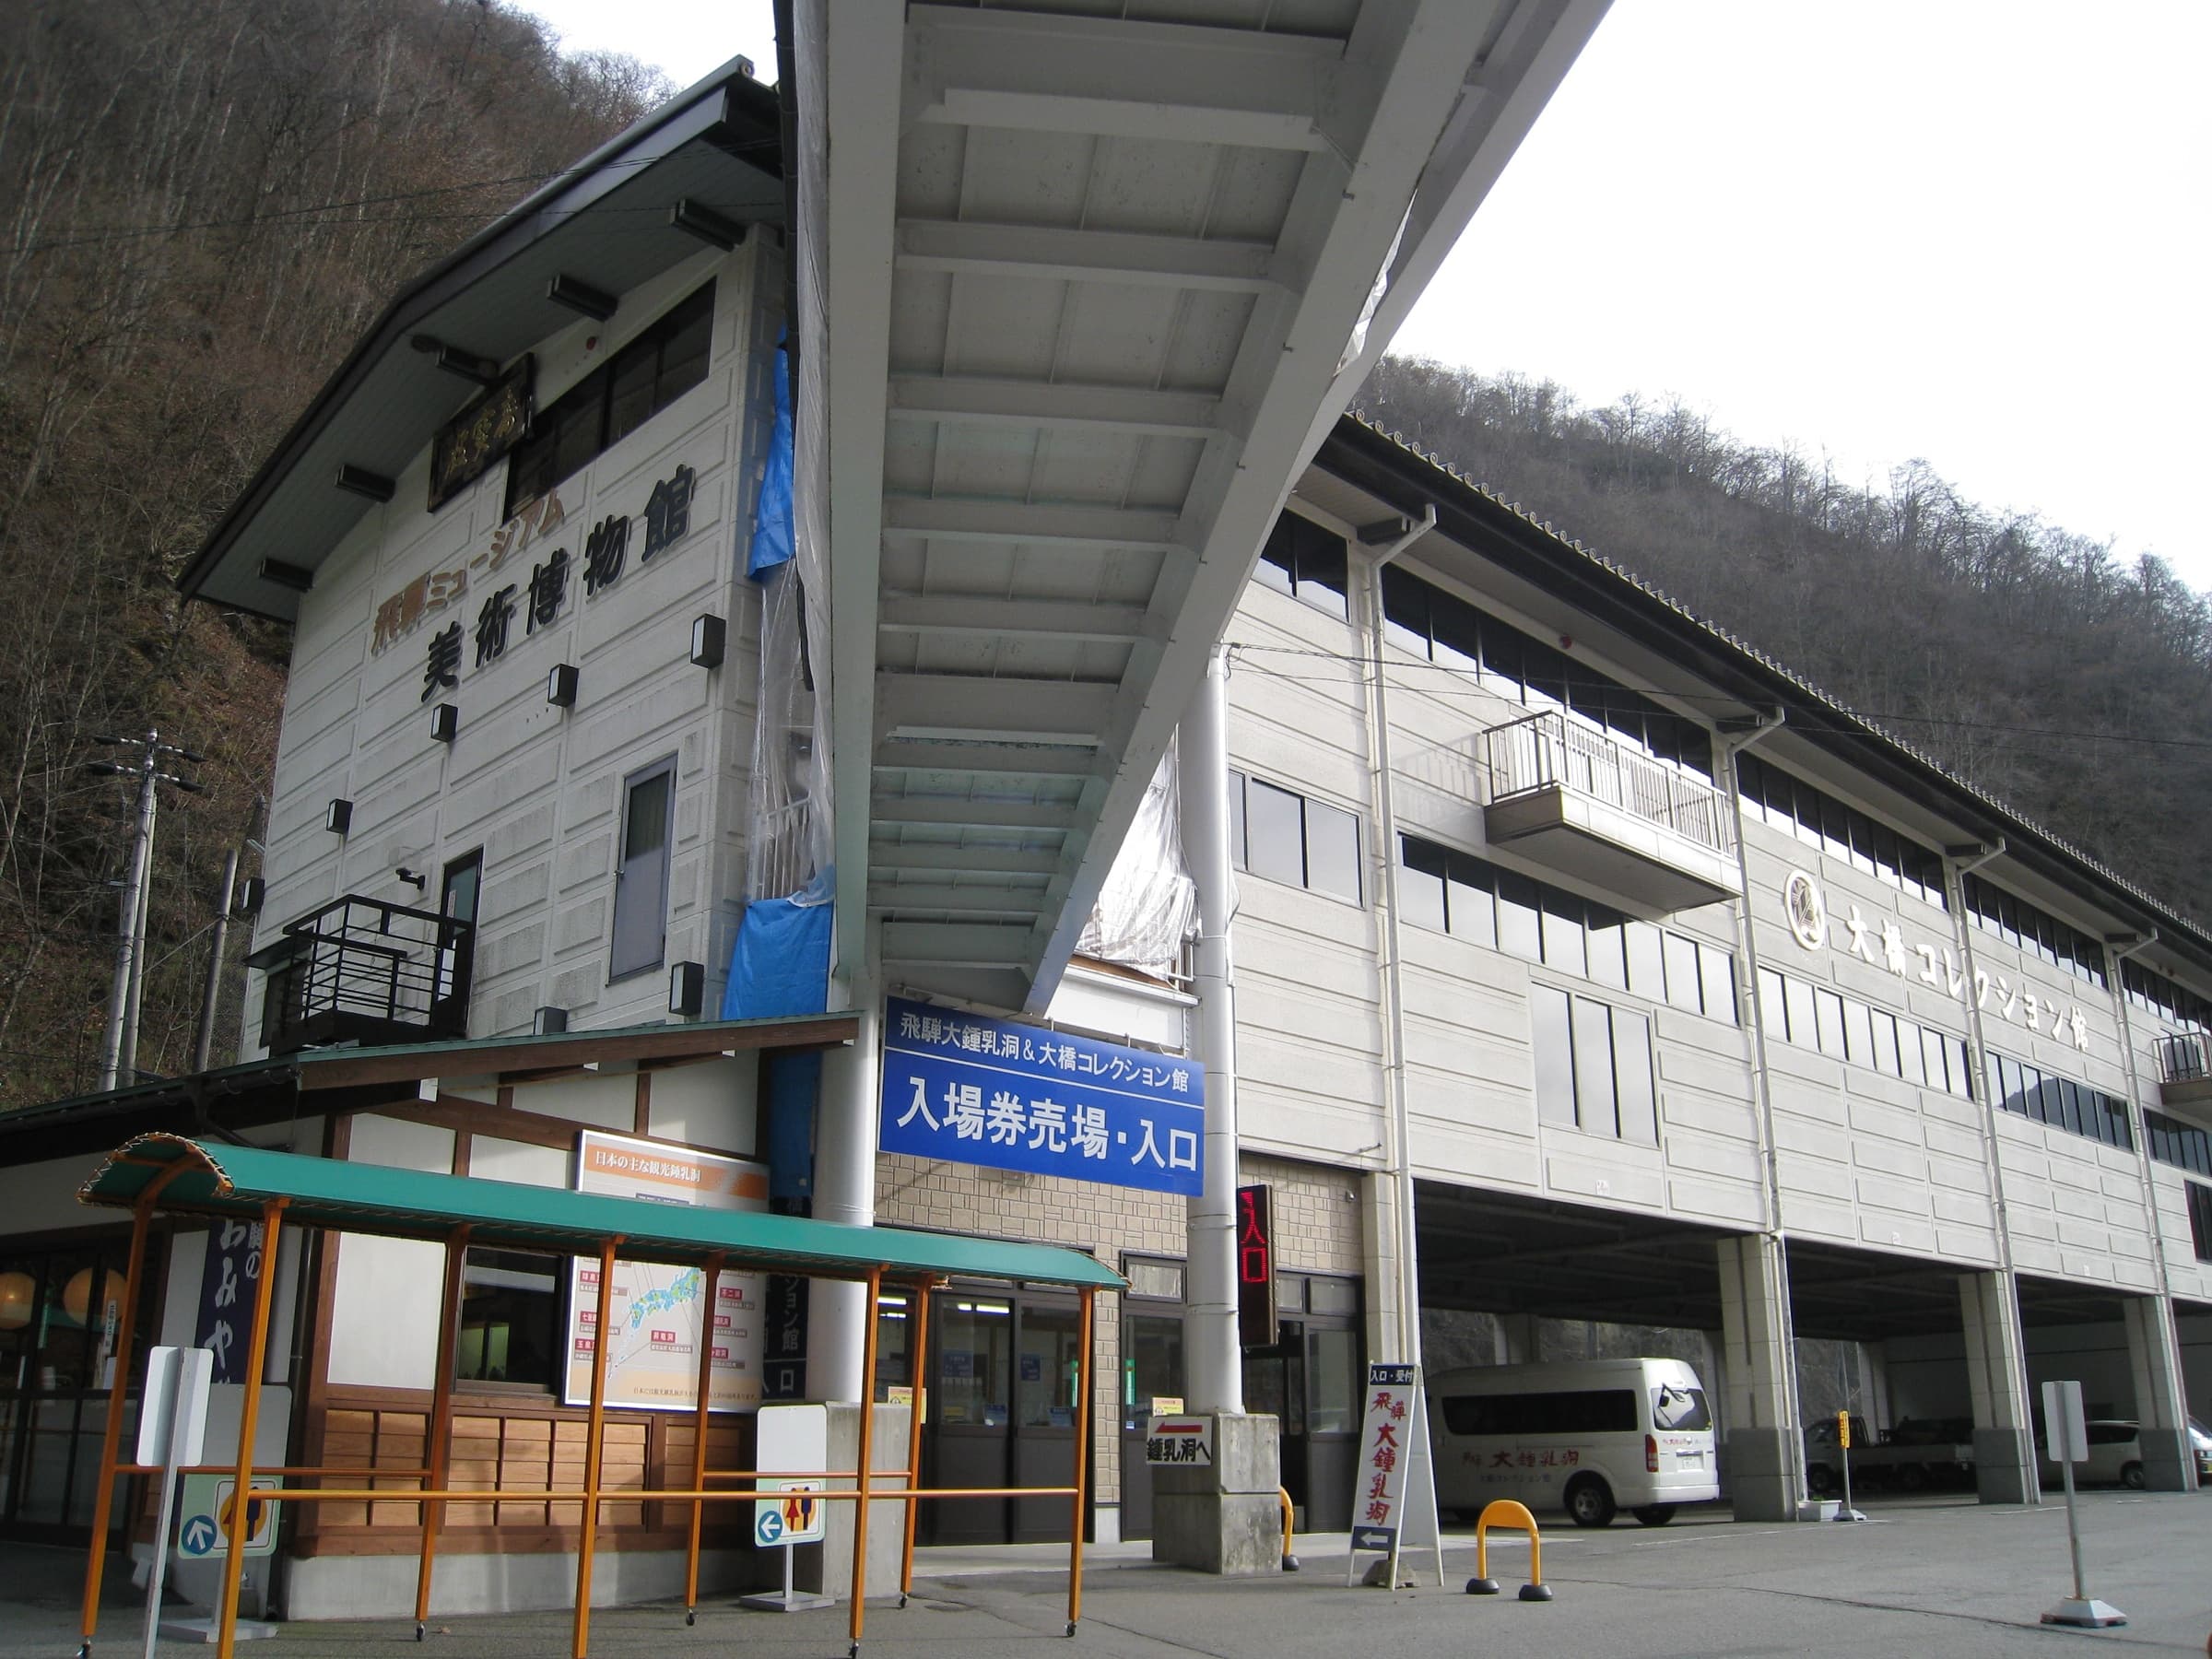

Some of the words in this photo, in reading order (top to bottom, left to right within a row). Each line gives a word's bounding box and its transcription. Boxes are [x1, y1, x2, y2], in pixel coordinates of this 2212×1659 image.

[420, 464, 698, 702] 美術博物館
[1845, 904, 2089, 1053] 大橋コレクション館
[897, 1076, 1198, 1172] 入場券売場・入口
[1241, 1207, 1267, 1283] 入口
[204, 1218, 246, 1383] おみや
[1371, 1370, 1414, 1383] 入口・受付
[1147, 1437, 1211, 1462] 鍾乳洞へ
